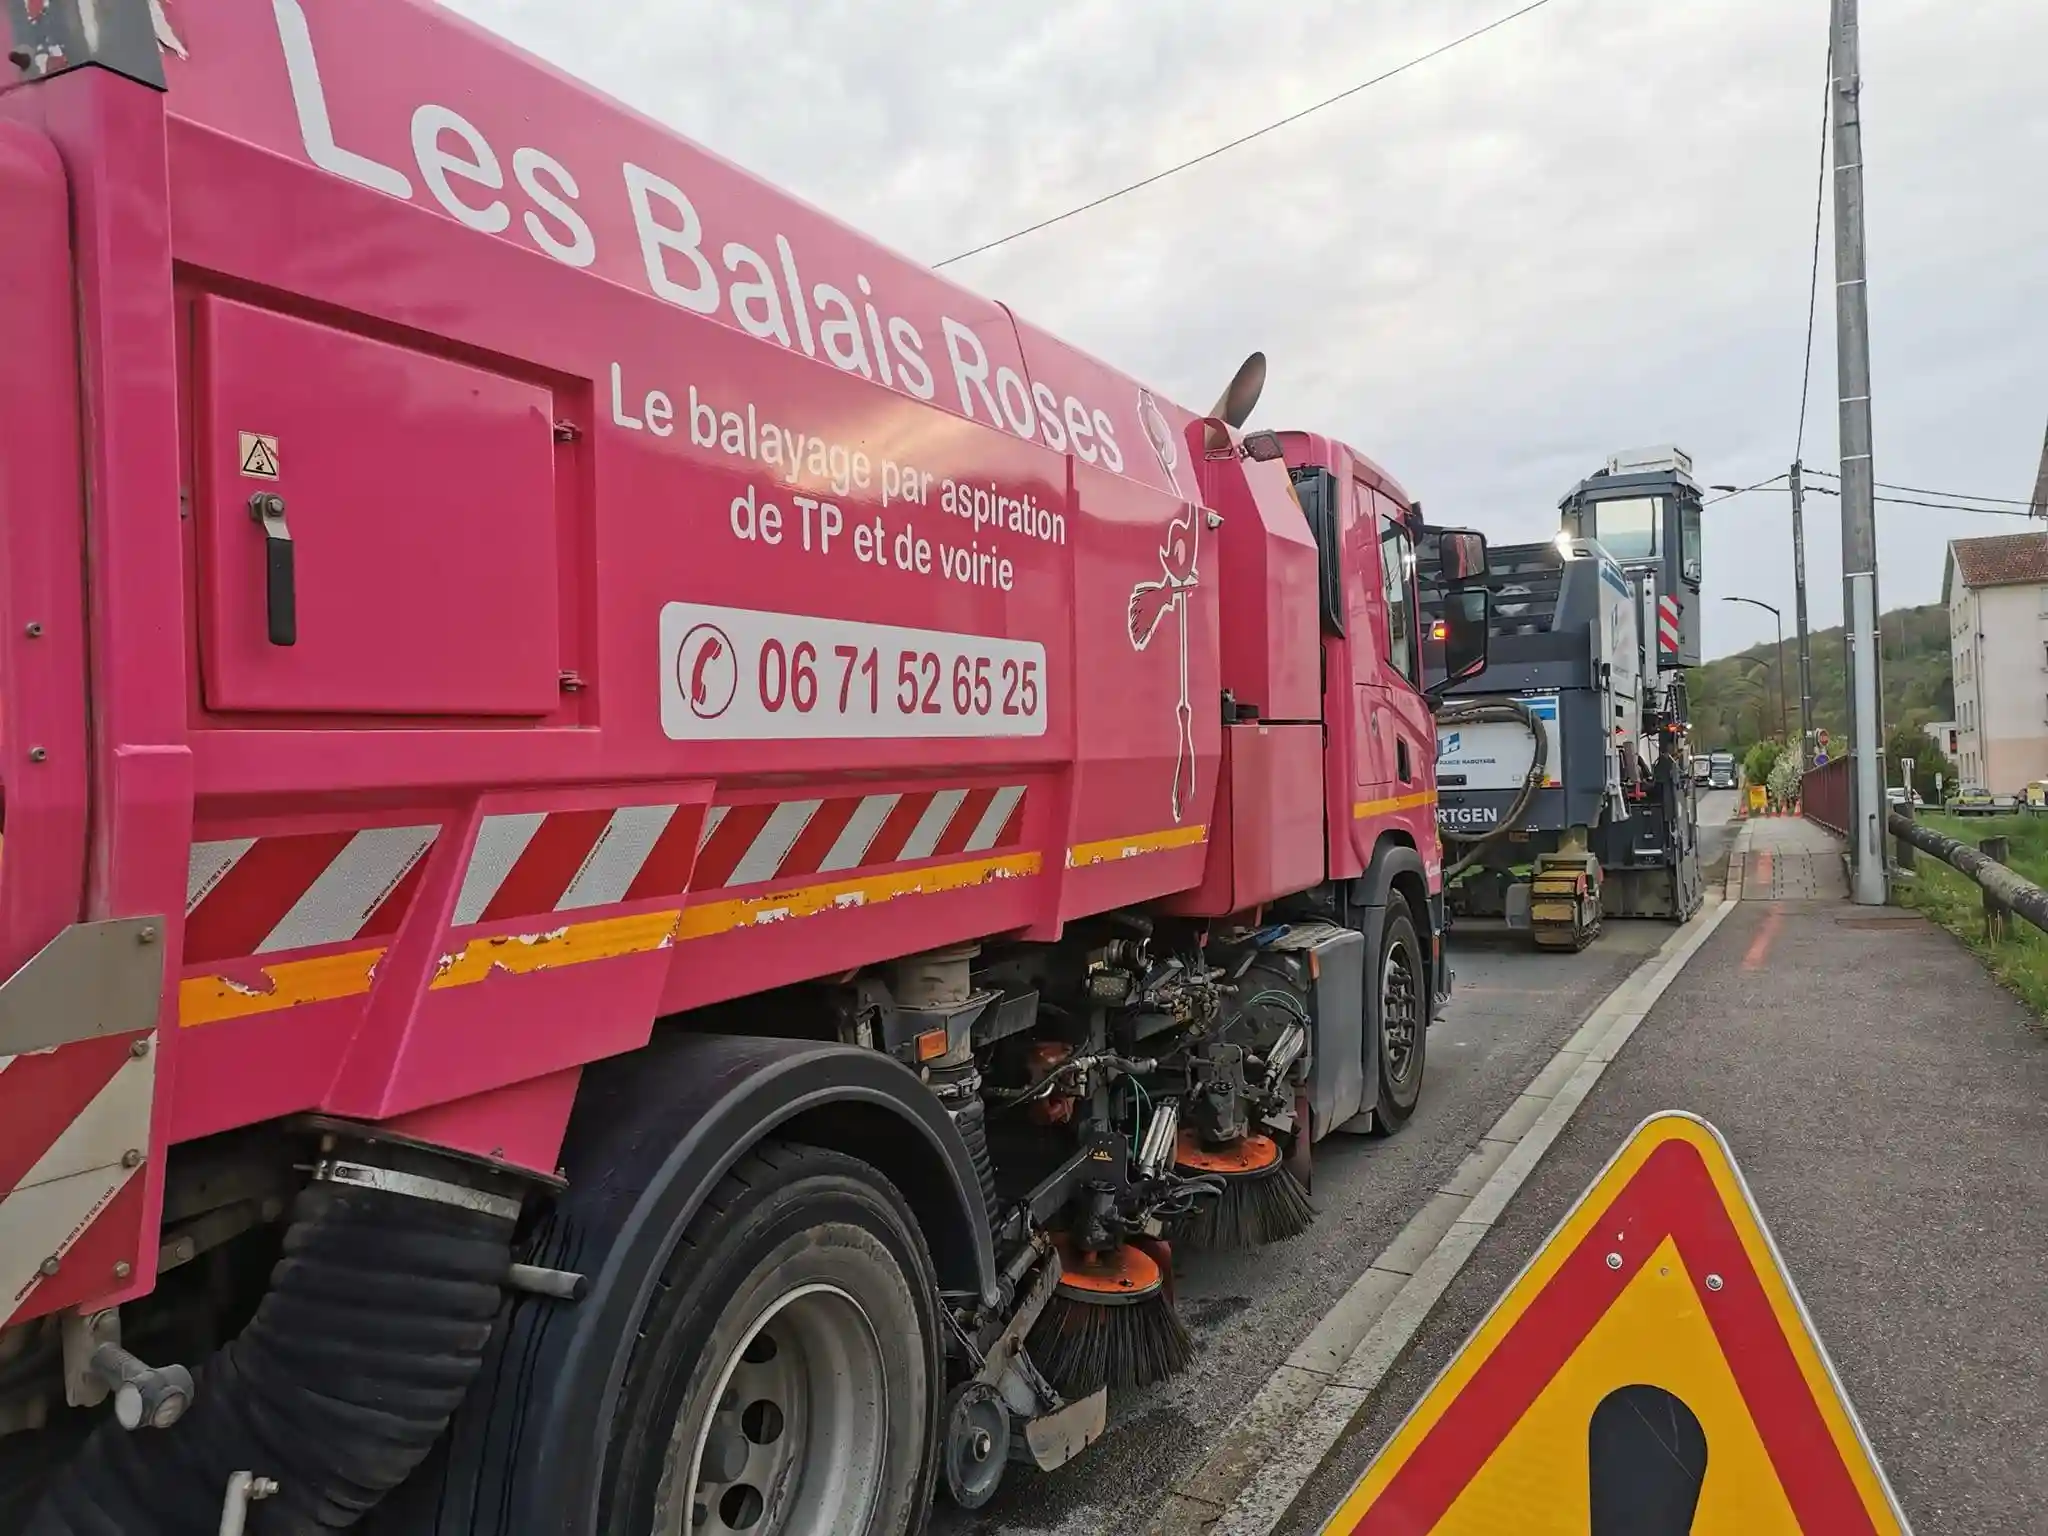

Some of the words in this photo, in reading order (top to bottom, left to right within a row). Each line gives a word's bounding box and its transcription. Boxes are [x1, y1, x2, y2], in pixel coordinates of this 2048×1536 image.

[273, 0, 596, 268] Les
[622, 162, 935, 402] Balais
[941, 315, 1124, 473] Roses
[610, 361, 674, 437] Le
[689, 385, 872, 497] balayage
[881, 457, 934, 508] par
[940, 477, 1066, 545] aspiration
[730, 484, 783, 545] de
[793, 495, 844, 554] TP
[853, 516, 888, 567] et
[894, 523, 932, 575] de
[939, 541, 1014, 591] voirie
[758, 637, 818, 713] 06
[834, 645, 879, 715] 71
[896, 650, 942, 715] 52
[952, 654, 992, 716] 65
[1001, 658, 1038, 716] 25
[1438, 807, 1498, 823] RTGEN
